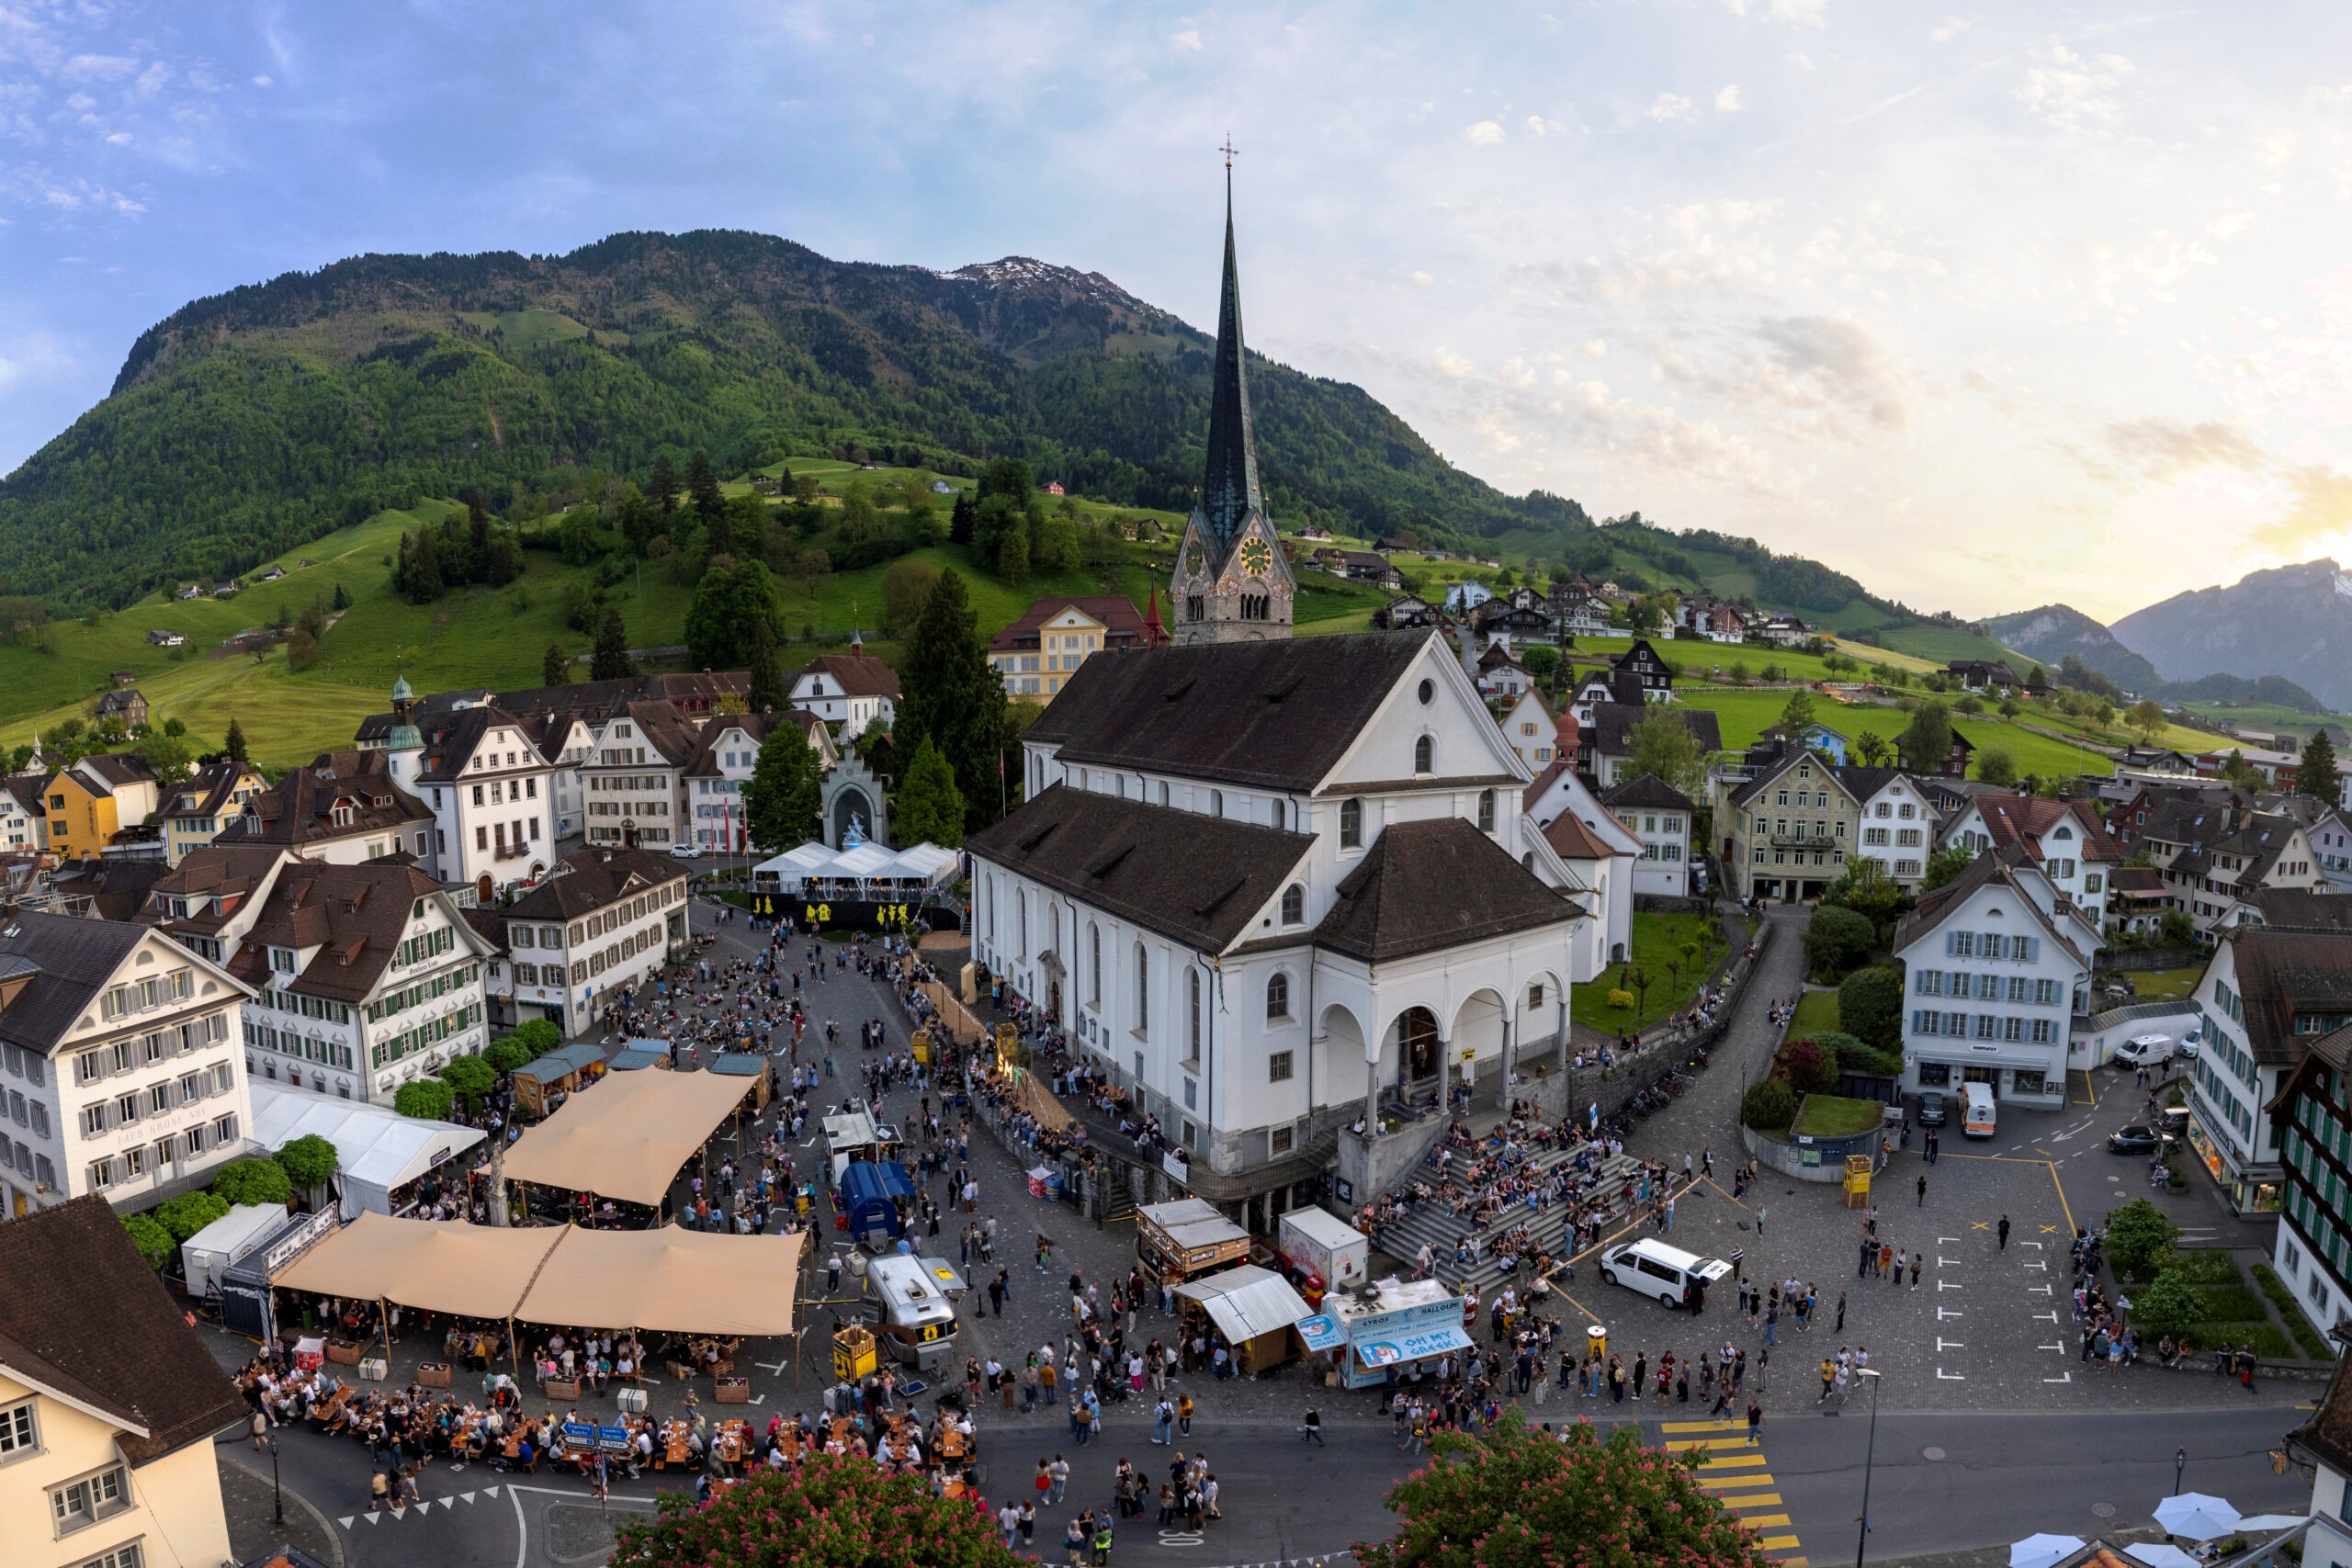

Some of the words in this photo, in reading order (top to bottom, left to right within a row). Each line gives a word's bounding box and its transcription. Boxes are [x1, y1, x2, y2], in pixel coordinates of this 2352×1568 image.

[118, 1129, 143, 1145] HAUS
[150, 1115, 183, 1134] KRONE
[1421, 1302, 1459, 1314] HALLOUMI
[1362, 1315, 1389, 1326] GYROS
[1405, 1337, 1427, 1347] OH
[1430, 1331, 1450, 1342] MY
[1410, 1338, 1461, 1355] GREEK!
[1158, 1529, 1204, 1546] 30
